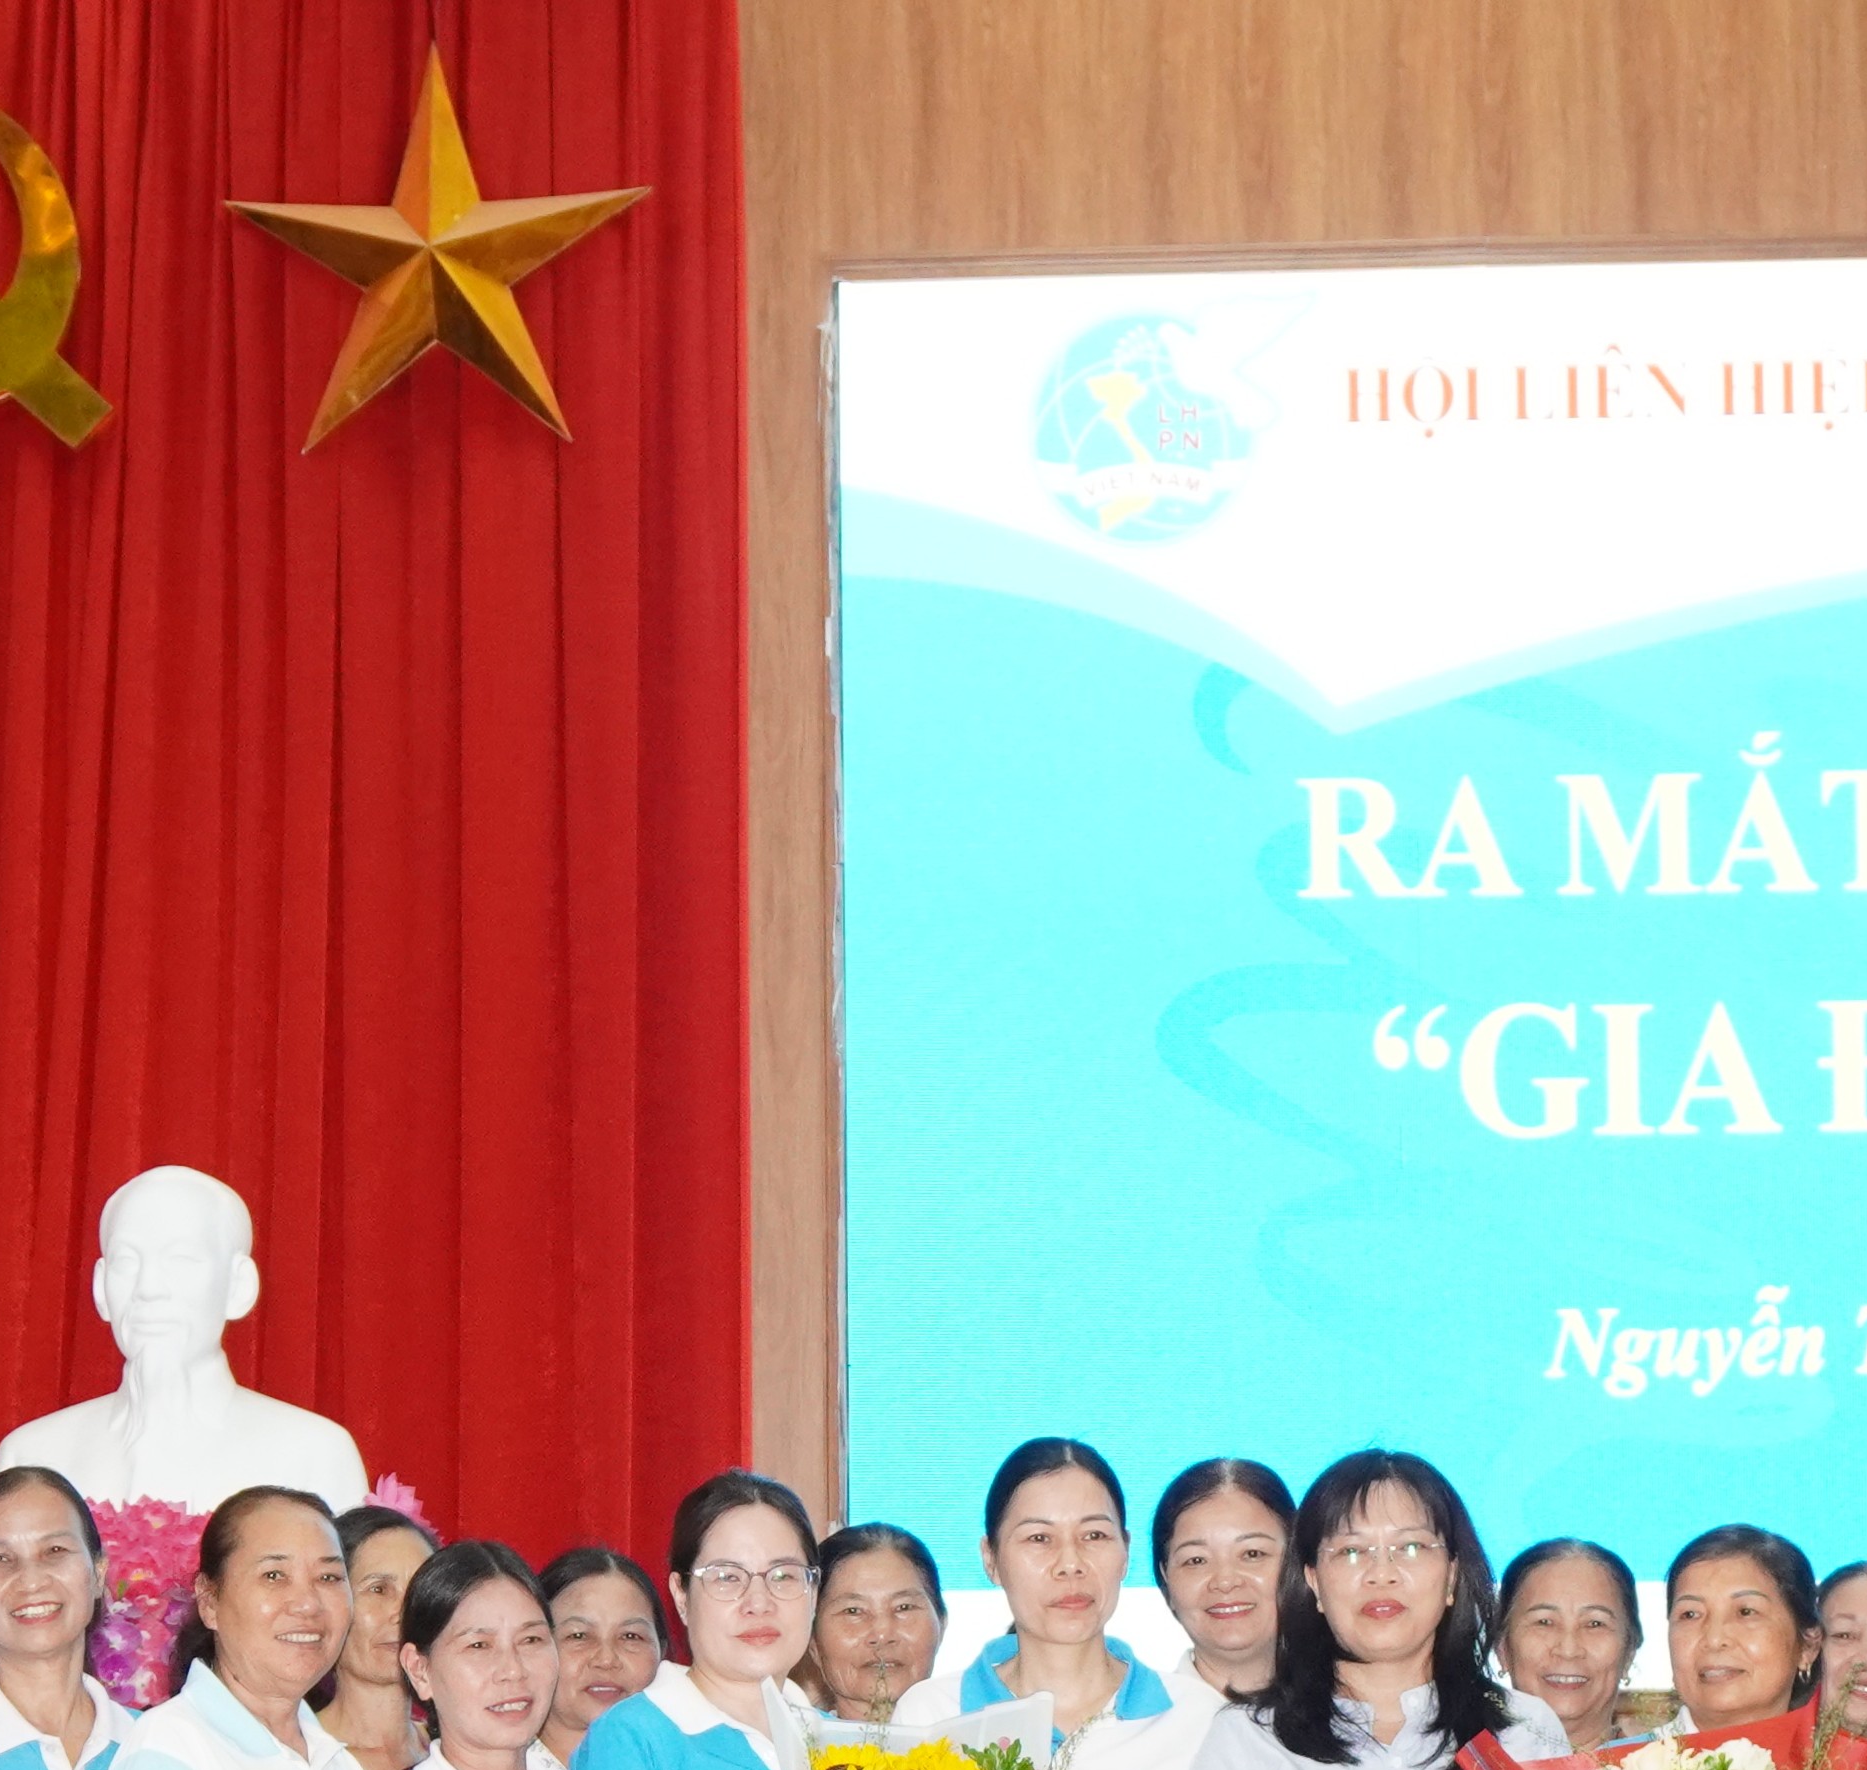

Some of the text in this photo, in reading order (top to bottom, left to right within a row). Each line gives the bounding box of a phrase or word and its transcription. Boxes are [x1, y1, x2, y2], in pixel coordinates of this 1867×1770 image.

[1345, 355, 1481, 438] HỘI
[1513, 342, 1688, 421] LIÊN
[1298, 775, 1523, 901] RA
[1545, 1286, 1827, 1399] Nguyễn
